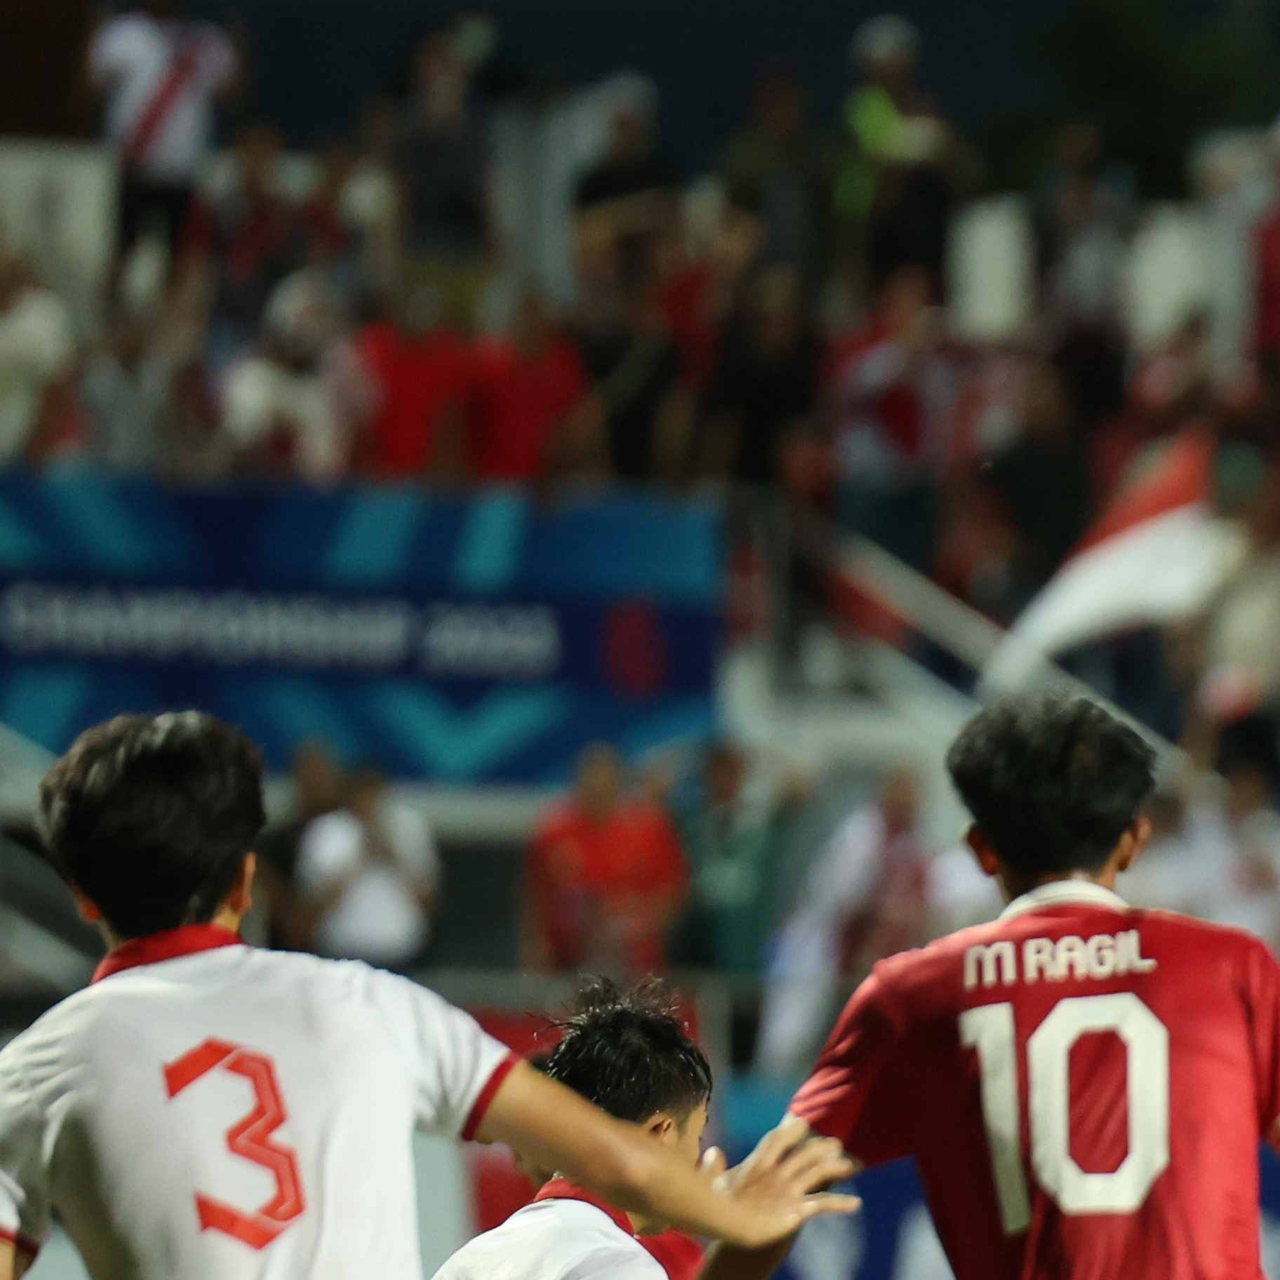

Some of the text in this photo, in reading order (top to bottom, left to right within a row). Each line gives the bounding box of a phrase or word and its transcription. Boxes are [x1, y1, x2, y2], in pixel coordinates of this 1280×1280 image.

[964, 930, 1157, 991] M RAGIL
[163, 1036, 305, 1250] 3
[959, 992, 1169, 1235] 10
